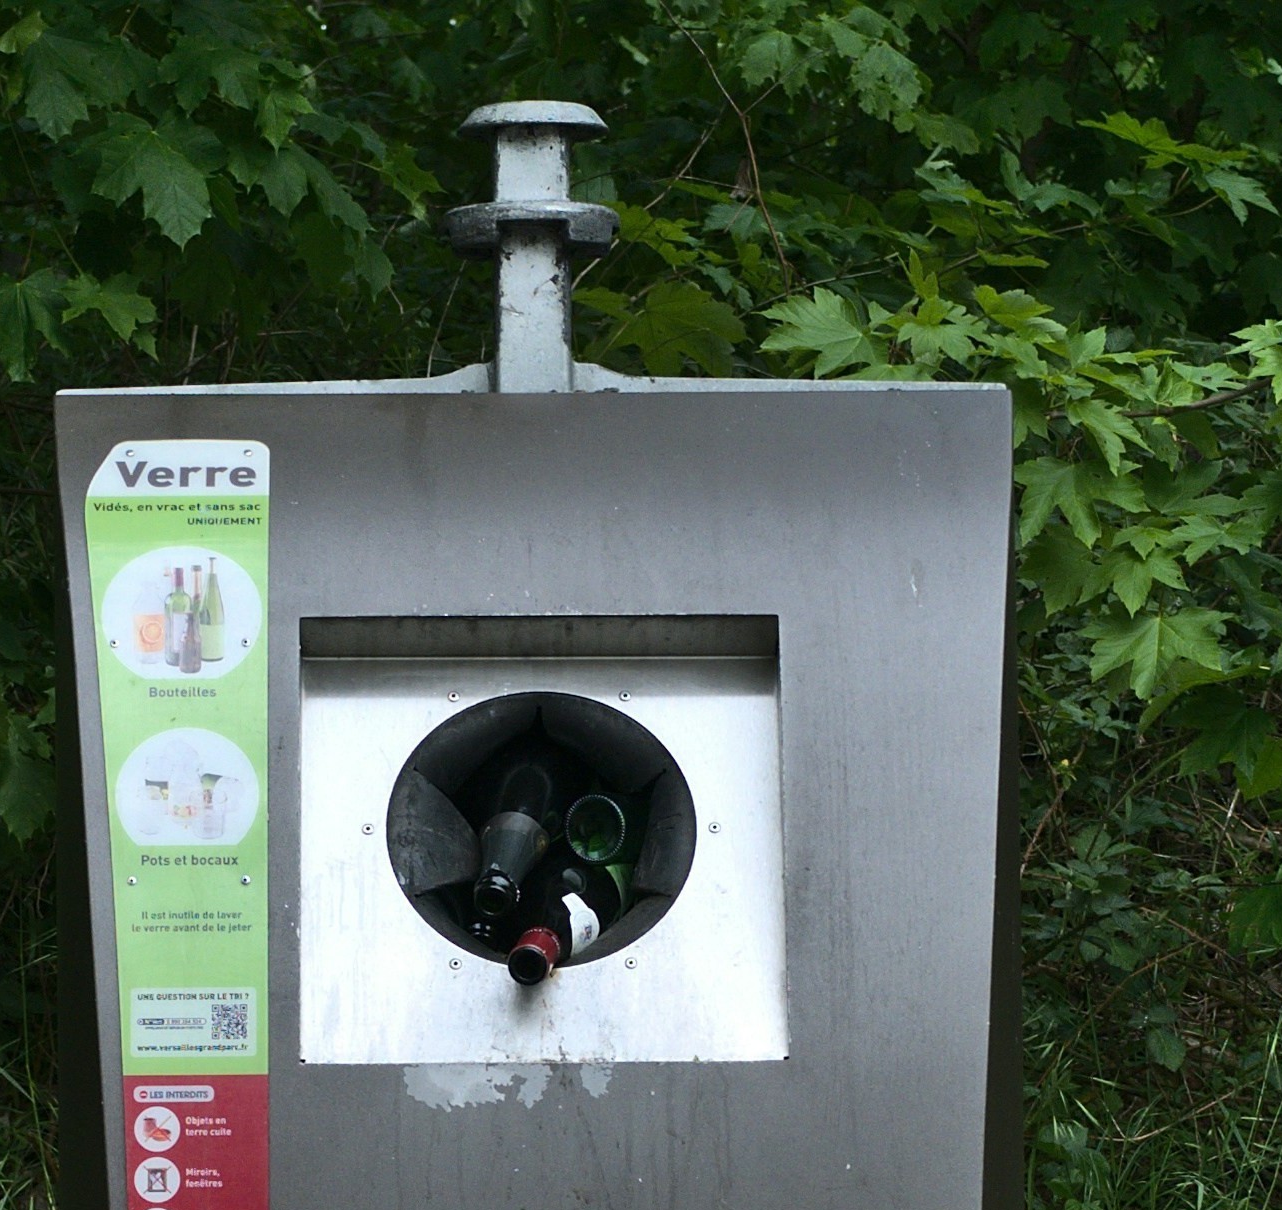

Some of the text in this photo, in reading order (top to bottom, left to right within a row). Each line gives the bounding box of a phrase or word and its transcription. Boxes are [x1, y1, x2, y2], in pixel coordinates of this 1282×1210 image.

[115, 461, 257, 488] Verre
[93, 502, 132, 513] Vidés,
[156, 504, 185, 512] vrac
[189, 503, 201, 512] et
[205, 504, 235, 512] sans
[238, 504, 261, 512] sac
[187, 517, 262, 526] UNIQUEMENT
[149, 687, 217, 698] Bouteilles
[141, 854, 239, 867] Pots et bocaux
[141, 910, 242, 920] Il est inutile de laver
[131, 922, 252, 934] le verre avant de le jeter
[137, 993, 155, 1001] UNE
[156, 993, 197, 1001] QUESTION
[149, 1090, 209, 1099] LES INTERDITS
[185, 1116, 213, 1127] Objets
[185, 1127, 232, 1137] terre cuite
[185, 1167, 220, 1178] Miroirs,
[185, 1178, 223, 1188] fenêtres
